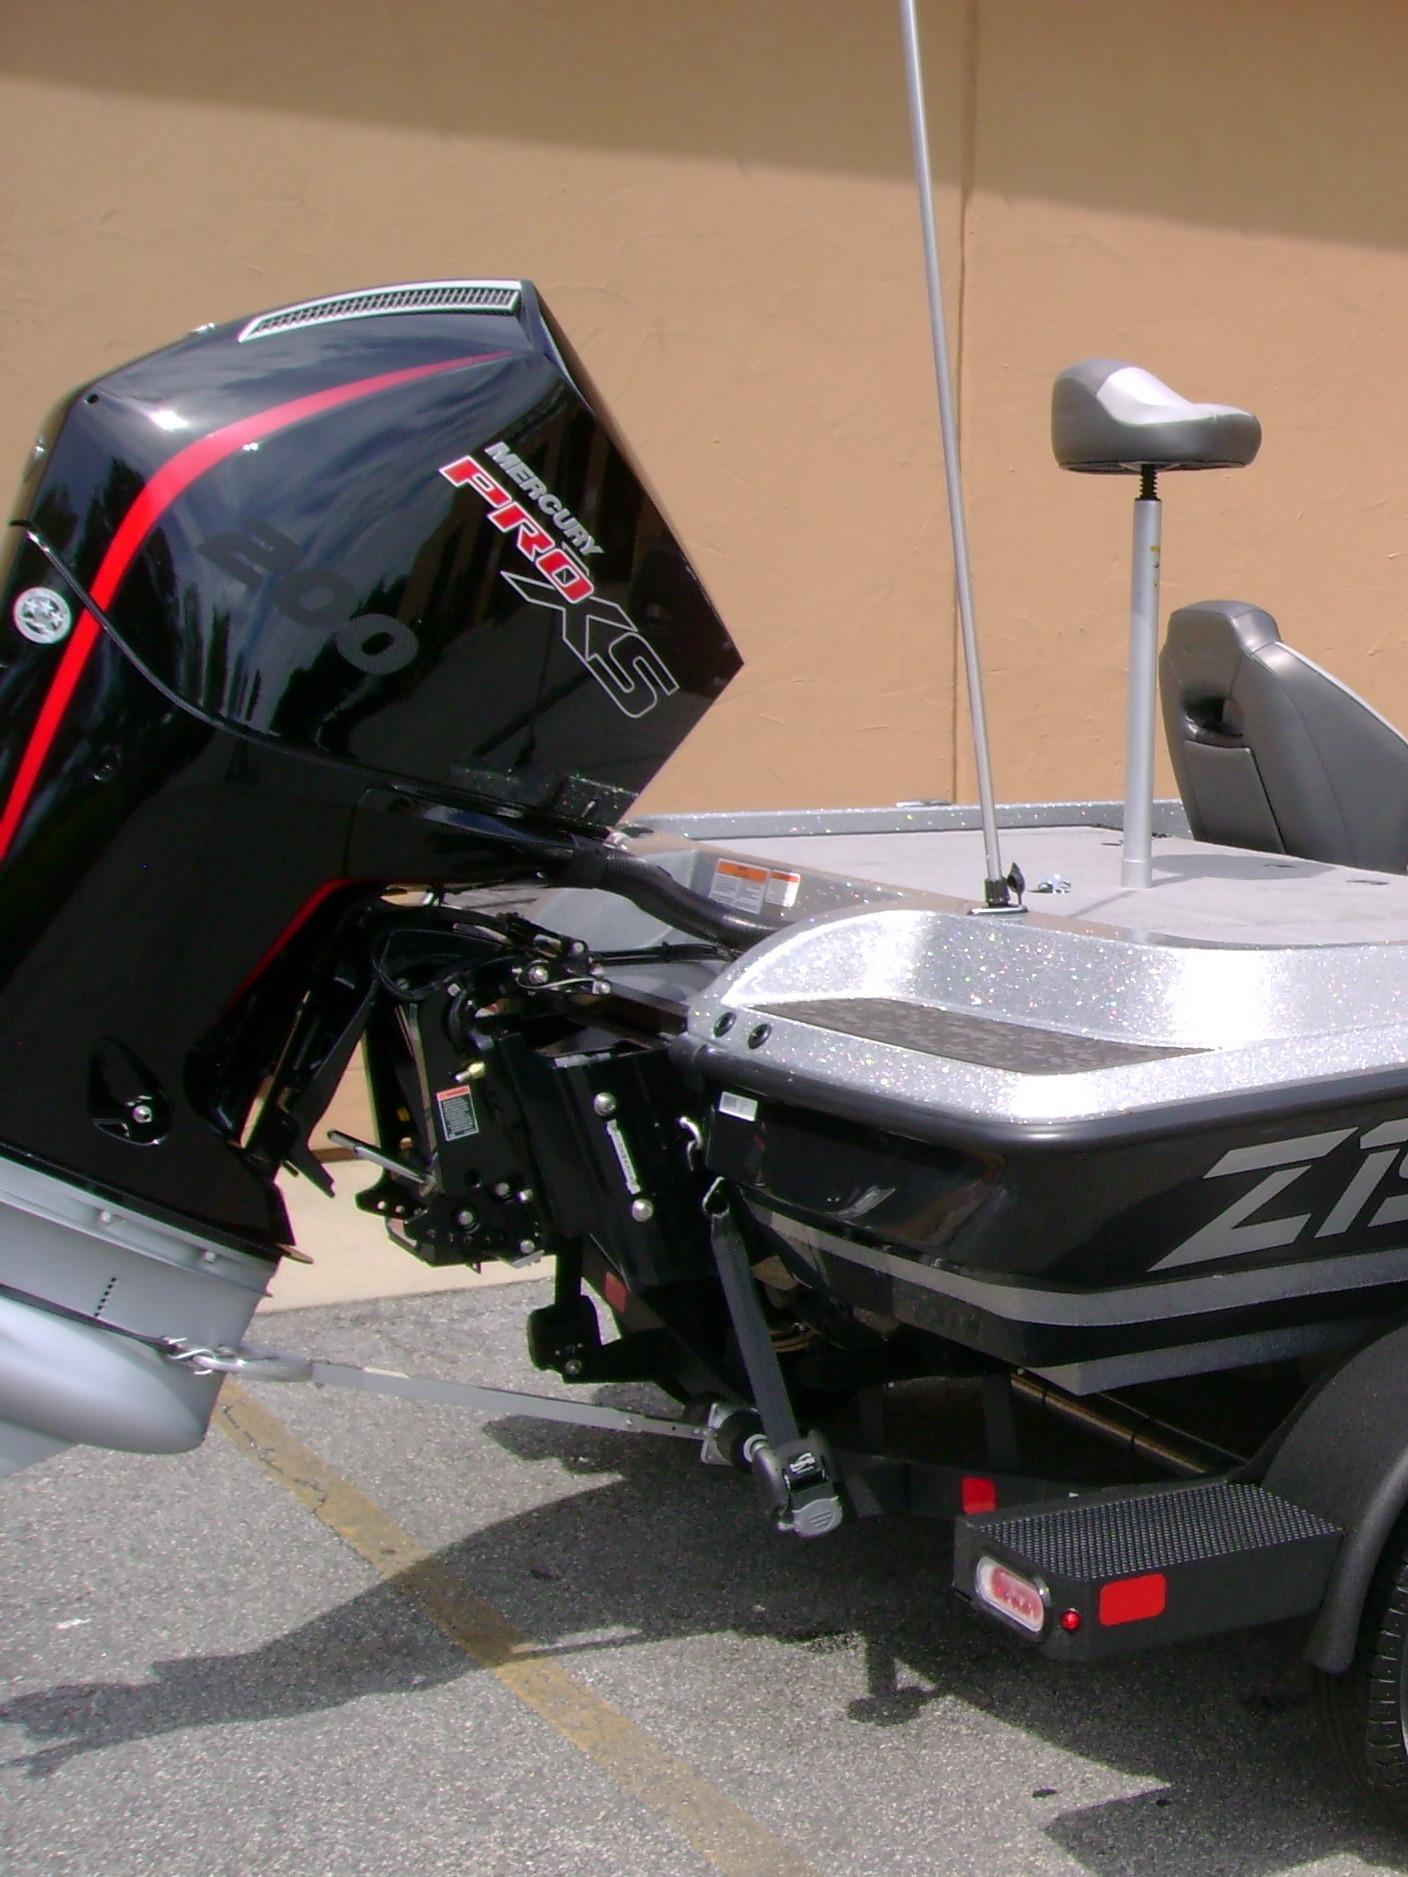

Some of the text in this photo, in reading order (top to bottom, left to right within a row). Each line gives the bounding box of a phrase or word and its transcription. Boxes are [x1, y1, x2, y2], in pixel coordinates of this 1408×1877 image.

[439, 455, 594, 603] PRO
[485, 441, 605, 556] MERCURY
[196, 516, 420, 675] 200
[500, 541, 680, 718] XS
